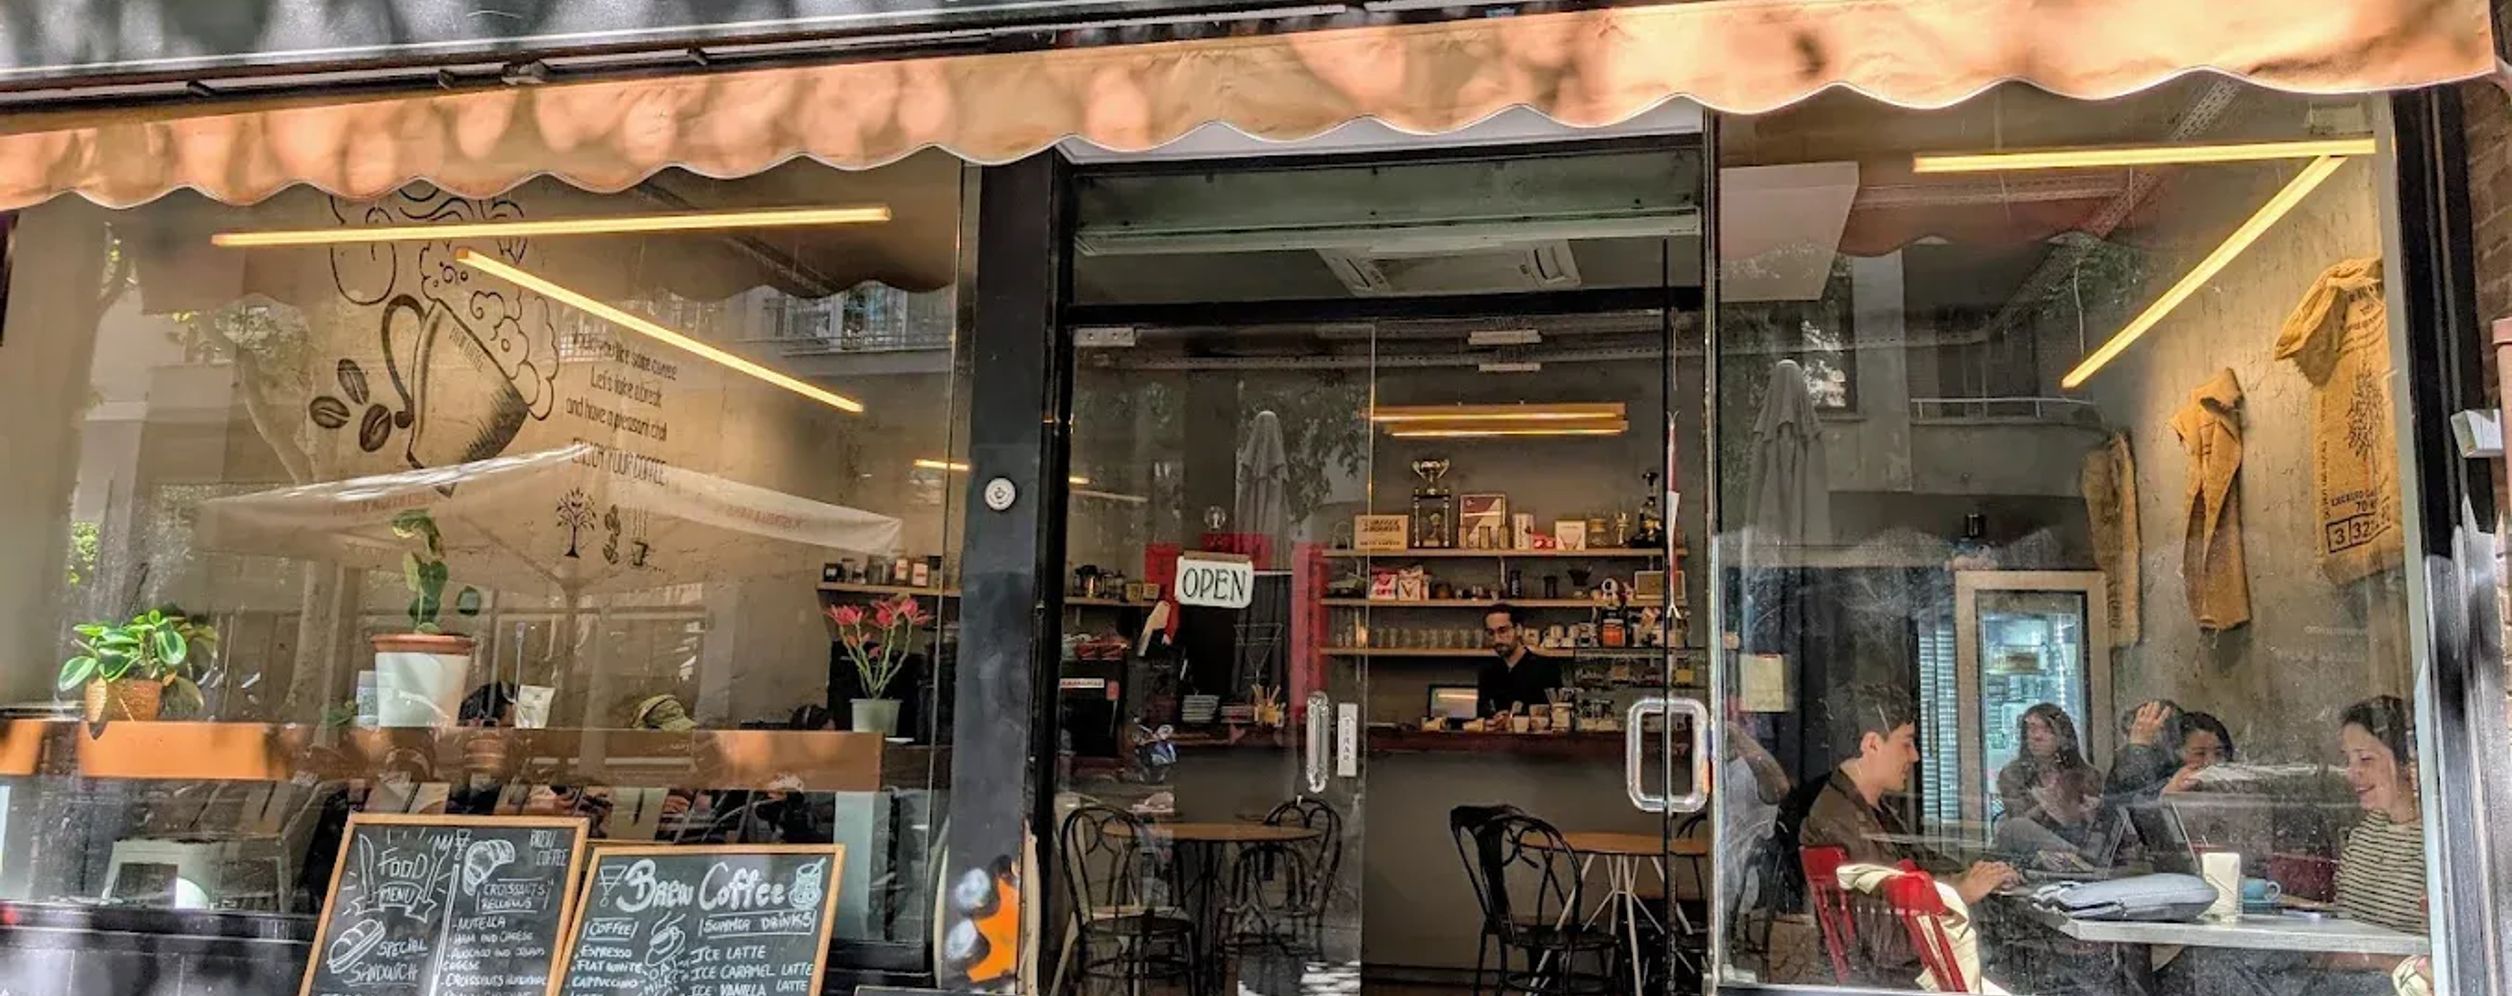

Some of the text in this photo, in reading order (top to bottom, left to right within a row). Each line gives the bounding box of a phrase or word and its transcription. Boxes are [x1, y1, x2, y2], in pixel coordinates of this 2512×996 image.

[566, 396, 584, 417] and
[585, 398, 606, 423] have
[2335, 528, 2345, 545] 3
[1182, 567, 1247, 601] OPEN
[378, 847, 428, 879] FOOD
[381, 887, 416, 904] MENU
[589, 922, 632, 936] COFFEE
[690, 945, 766, 963] ICE LATTE
[343, 962, 418, 984] SANDWICH
[690, 962, 814, 981] ICE CARAMEL LATTE
[776, 979, 808, 992] LATTE
